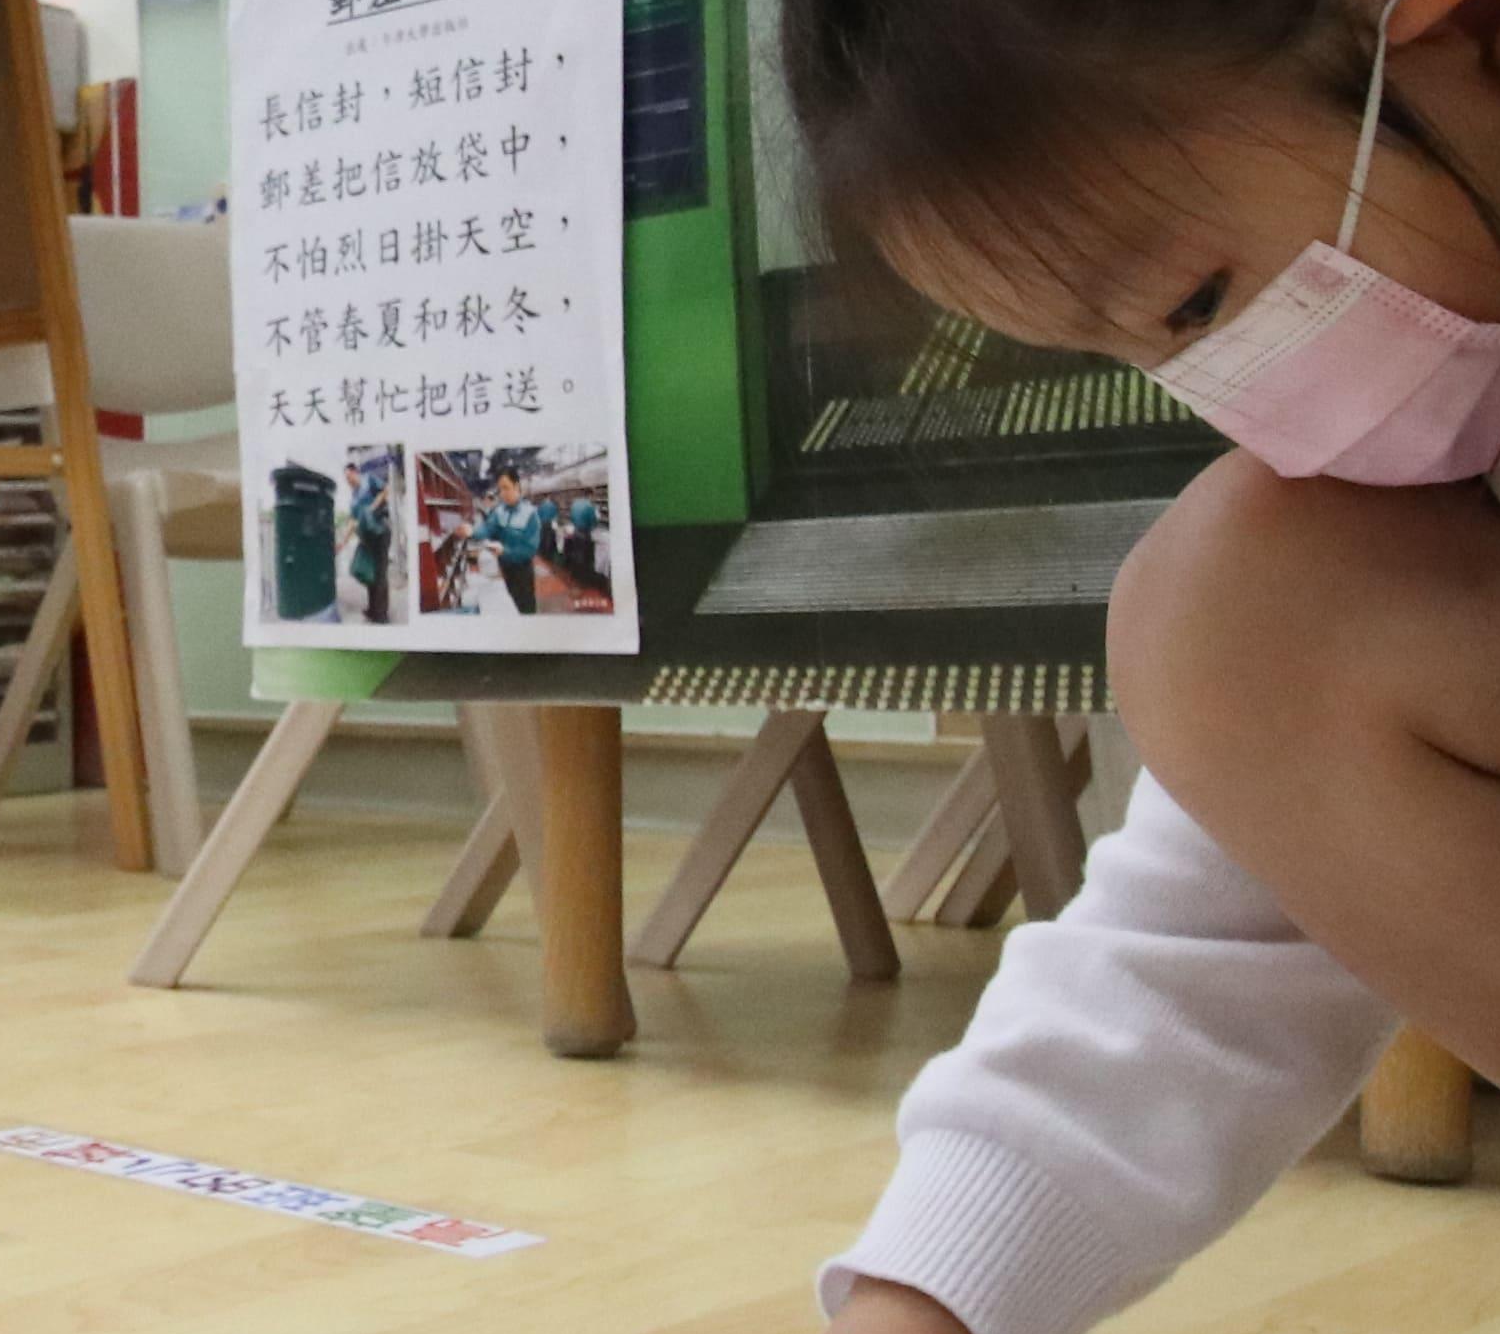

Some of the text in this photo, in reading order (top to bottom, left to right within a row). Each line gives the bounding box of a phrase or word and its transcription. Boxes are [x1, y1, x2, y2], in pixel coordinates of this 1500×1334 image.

[260, 48, 566, 141] 長信封，短信封，
[260, 125, 568, 213] 郵差把信放袋中，
[264, 208, 569, 284] 不怕烈日掛天空，
[266, 286, 572, 357] 不管春夏和秋冬，
[270, 367, 575, 429] 天天幫忙把信送。
